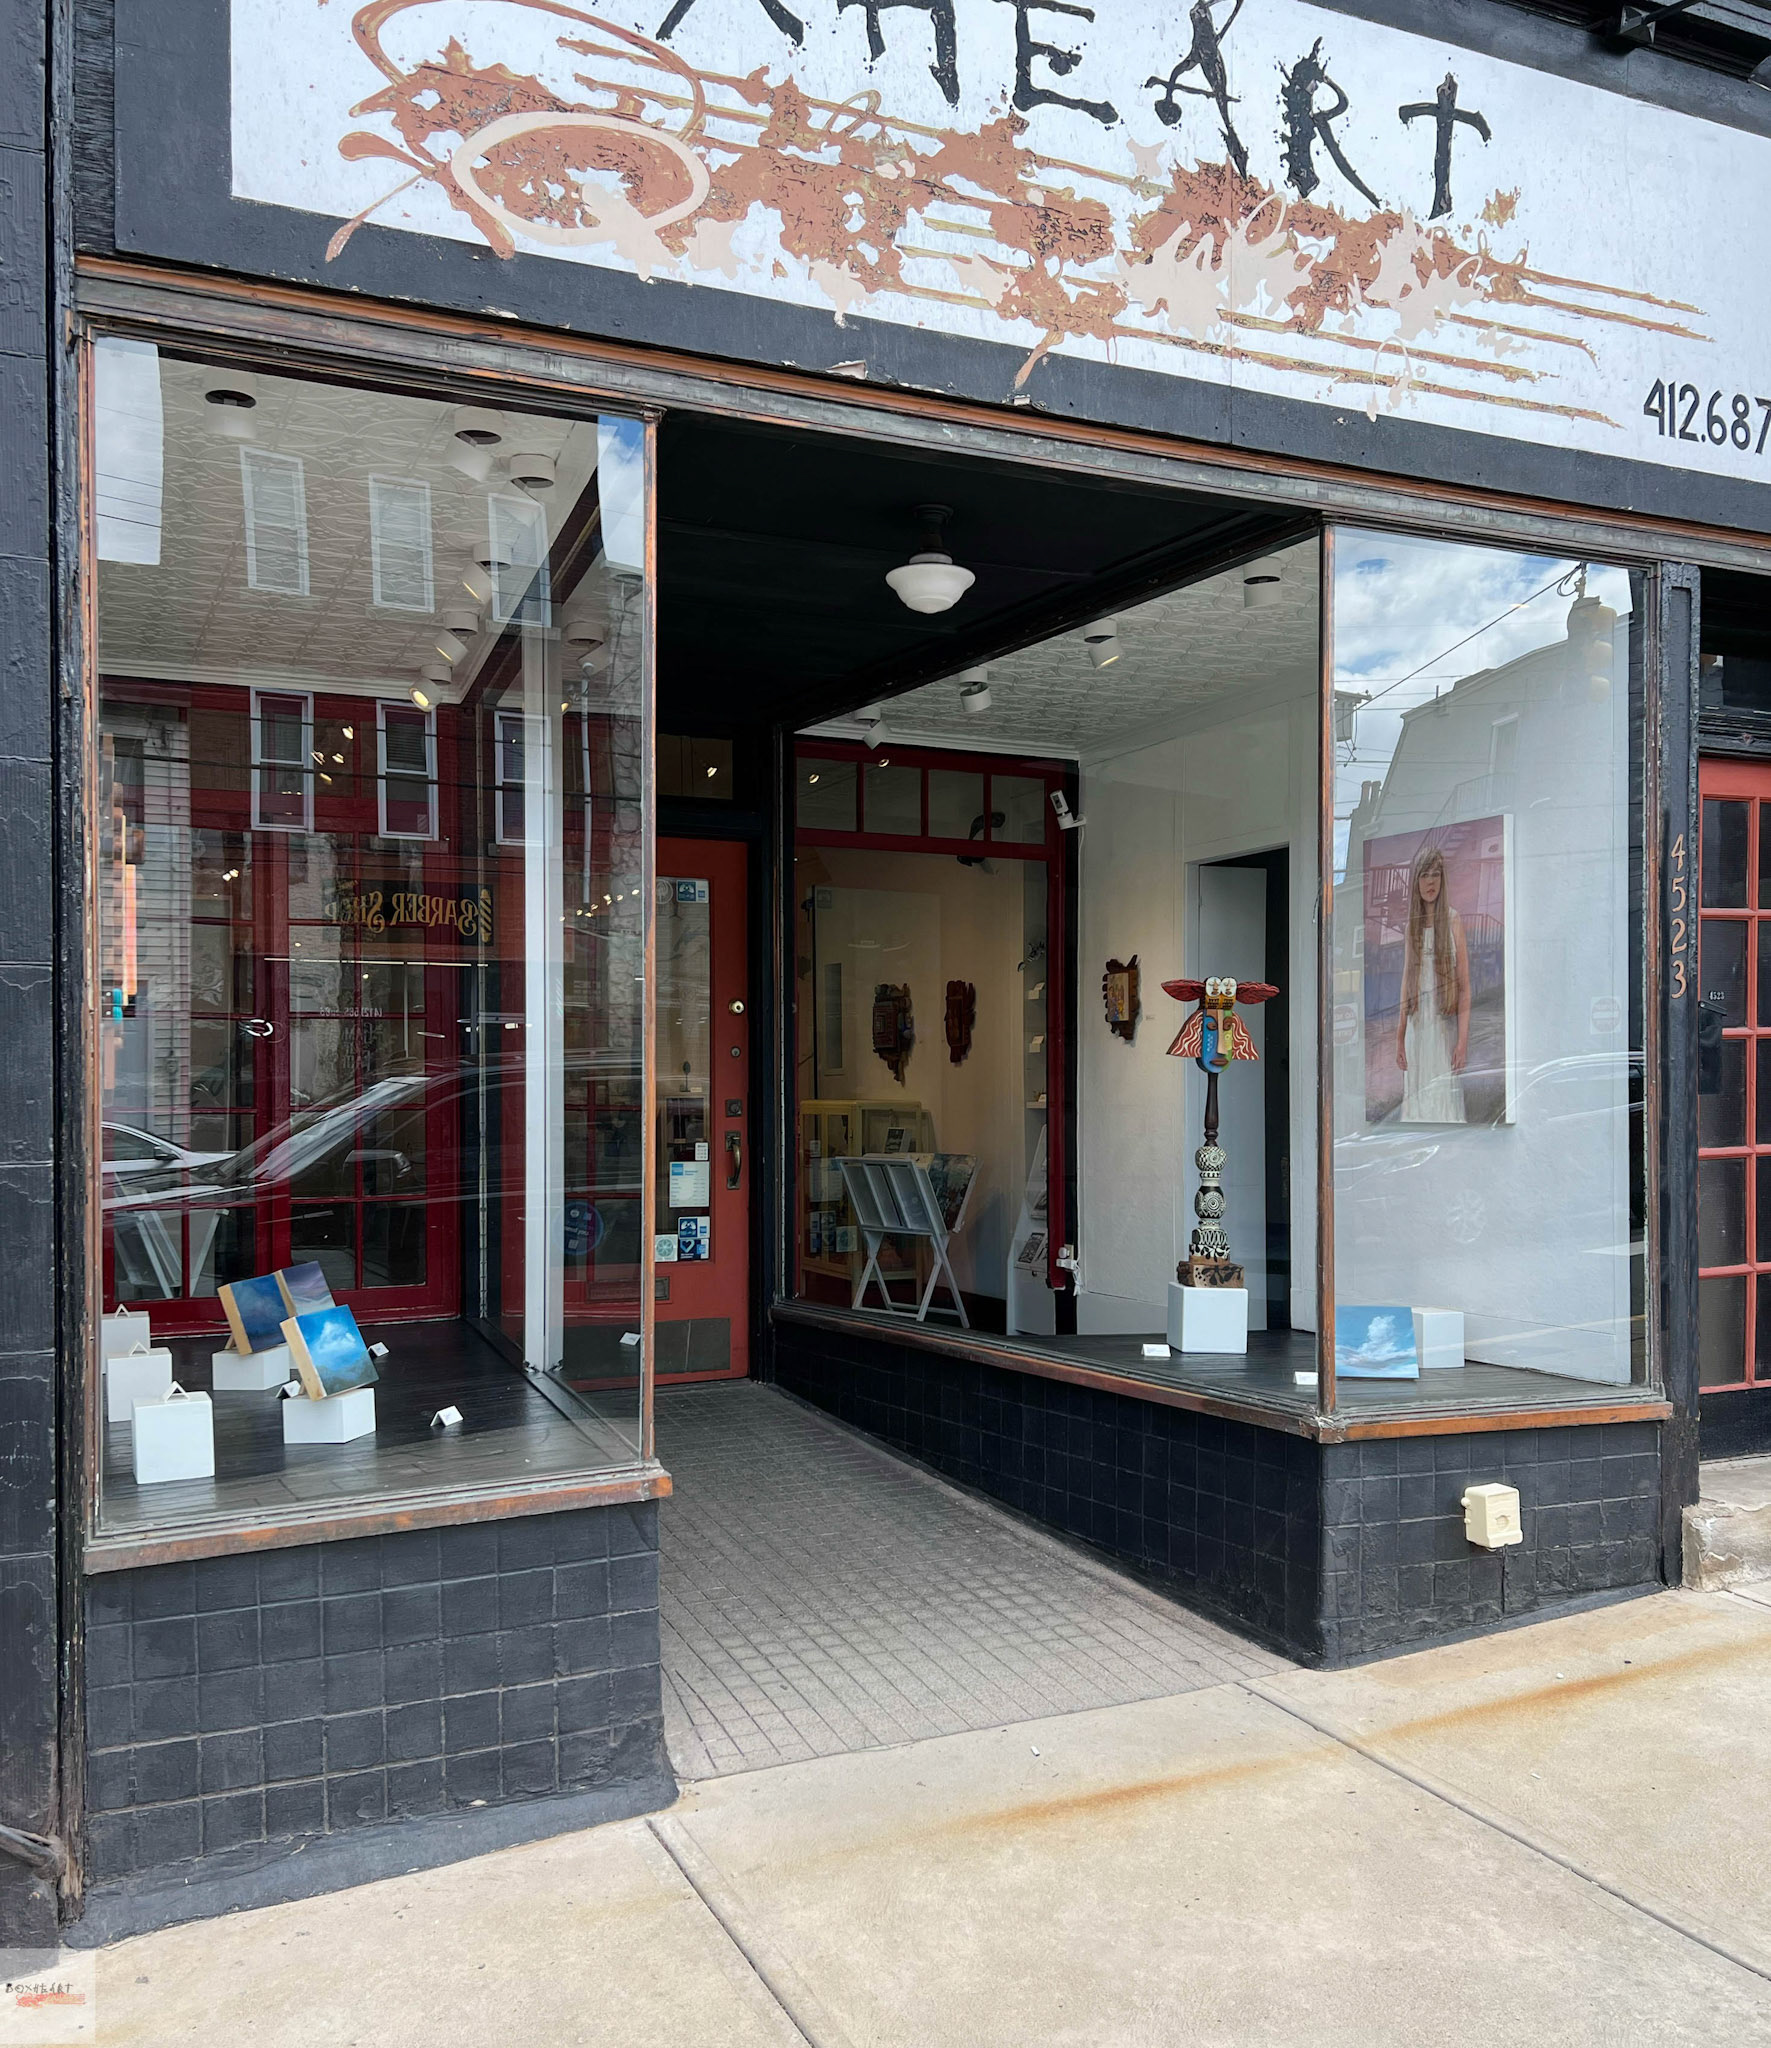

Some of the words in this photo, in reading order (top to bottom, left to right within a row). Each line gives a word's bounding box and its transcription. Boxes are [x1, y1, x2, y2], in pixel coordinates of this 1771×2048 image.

[1643, 377, 1771, 455] 412.687
[1670, 833, 1688, 999] 4523
[1709, 990, 1725, 1000] 4523
